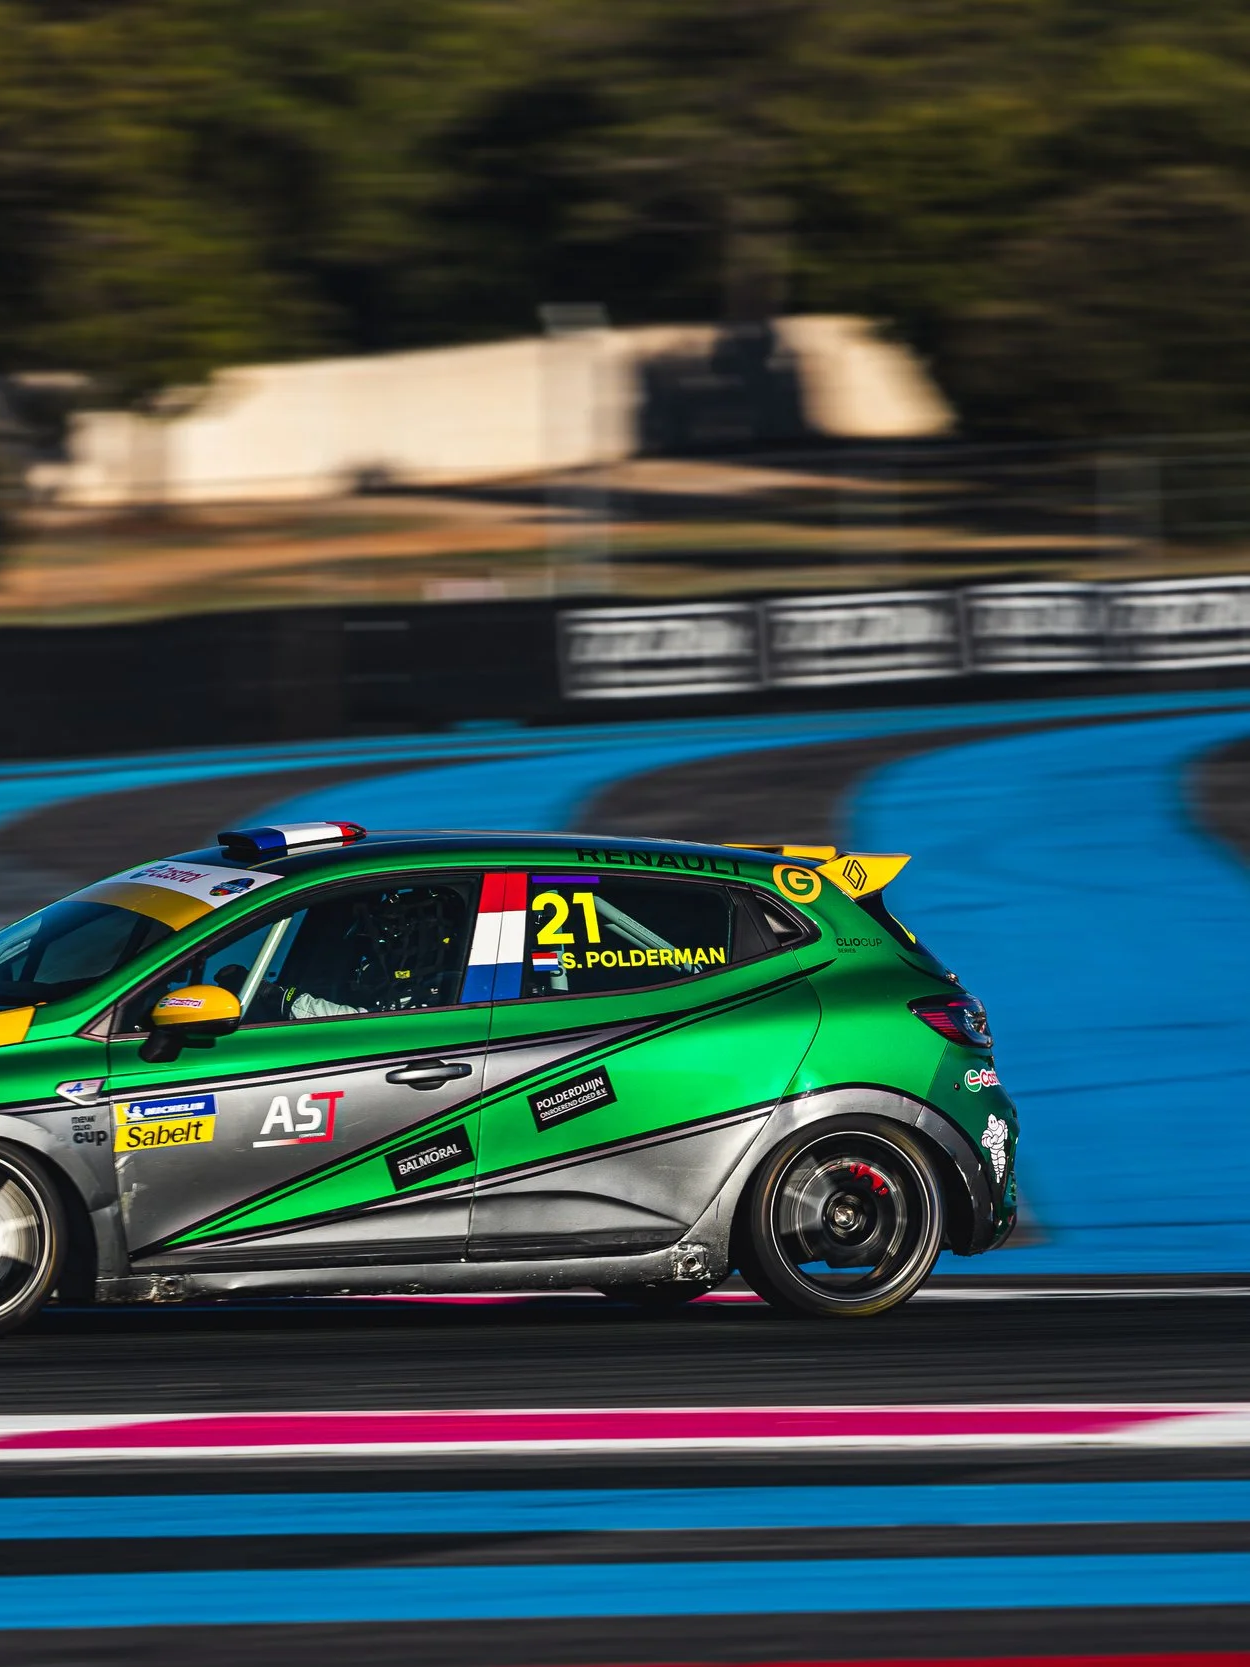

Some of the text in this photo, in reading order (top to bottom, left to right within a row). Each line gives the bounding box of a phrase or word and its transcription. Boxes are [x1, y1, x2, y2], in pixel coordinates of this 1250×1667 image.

[147, 866, 211, 884] Castrol
[577, 848, 741, 876] RENAULT
[531, 892, 601, 945] 21
[561, 947, 727, 970] S. POLDERMAN
[535, 1076, 605, 1111] POLDERDUIJN
[539, 1099, 579, 1119] ONROEREND
[577, 1091, 597, 1104] GOED
[144, 1101, 206, 1117] MICHELIN
[259, 1090, 345, 1141] AST
[73, 1130, 108, 1147] cup
[126, 1120, 203, 1148] Sabelt
[397, 1143, 462, 1176] BALMORAL
